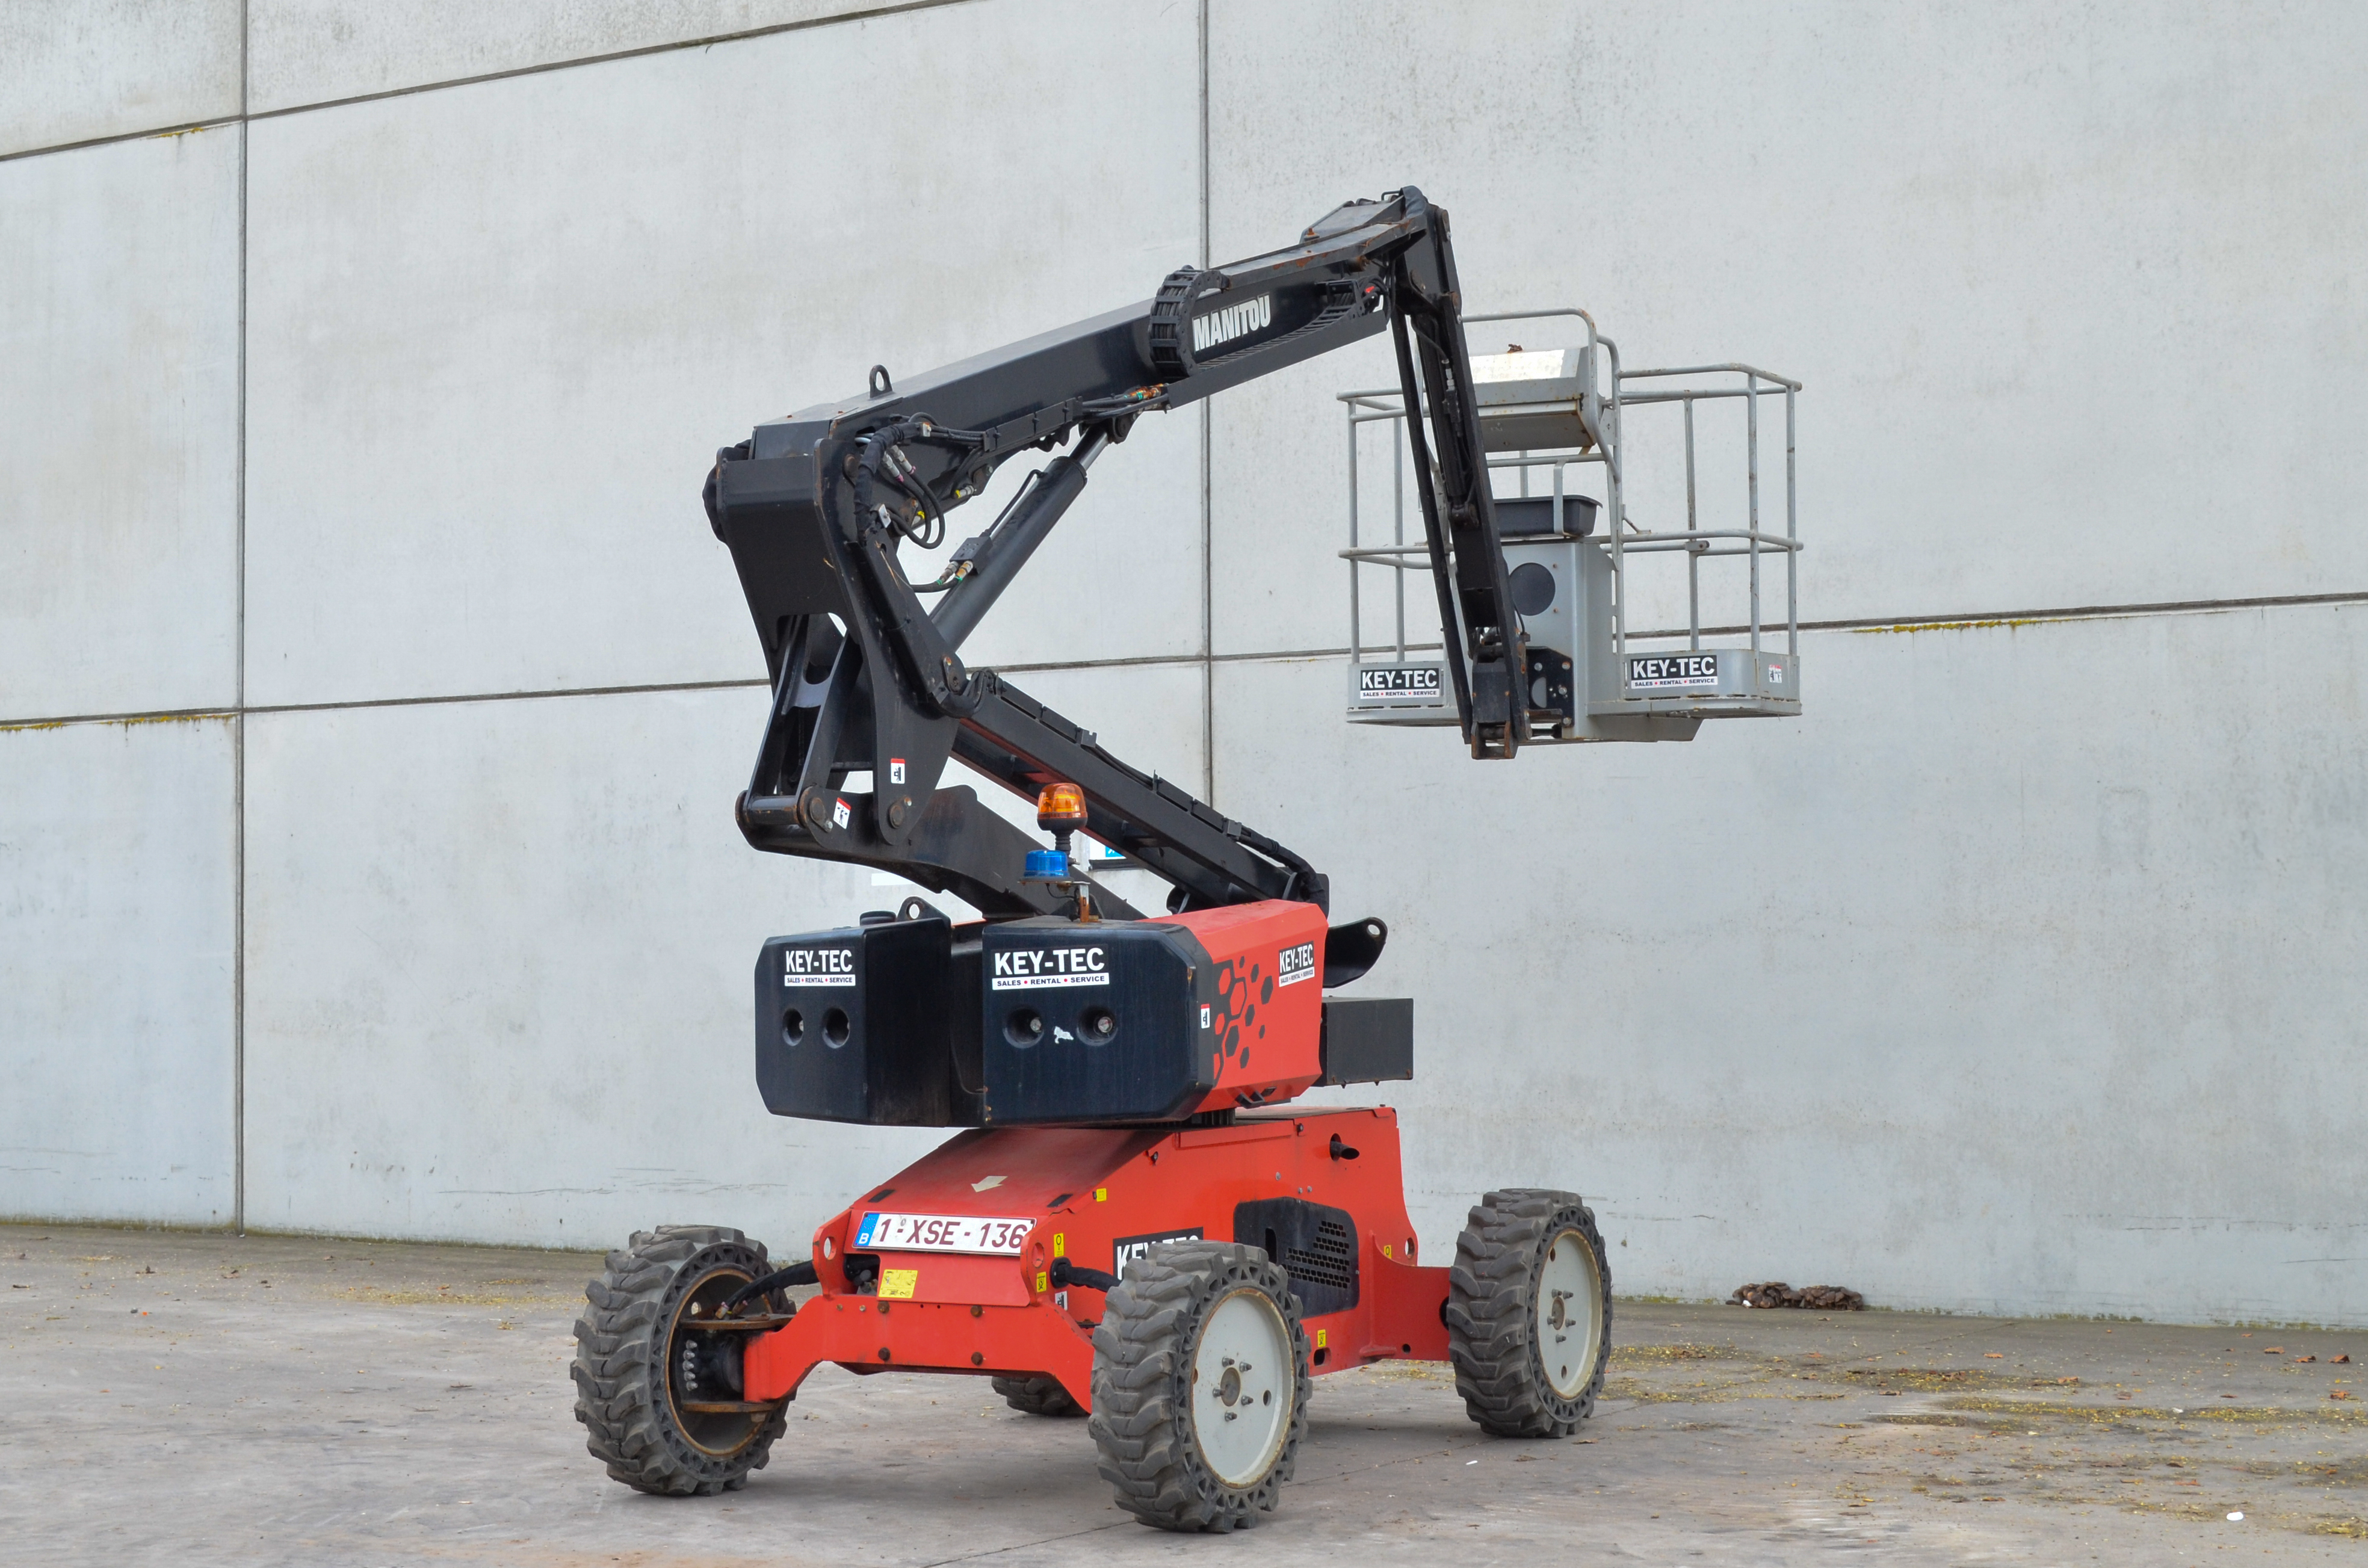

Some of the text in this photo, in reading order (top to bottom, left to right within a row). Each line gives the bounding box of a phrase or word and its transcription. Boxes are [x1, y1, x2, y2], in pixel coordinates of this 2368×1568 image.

[1192, 293, 1271, 353] MANITOU
[1633, 657, 1715, 678] KEY-TEC
[1362, 670, 1437, 689] KEY-TEC
[785, 949, 853, 972] KEY-TEC
[994, 948, 1105, 975] KEY-TEC
[1279, 943, 1313, 974] KEY-TEC
[859, 1233, 870, 1244] B
